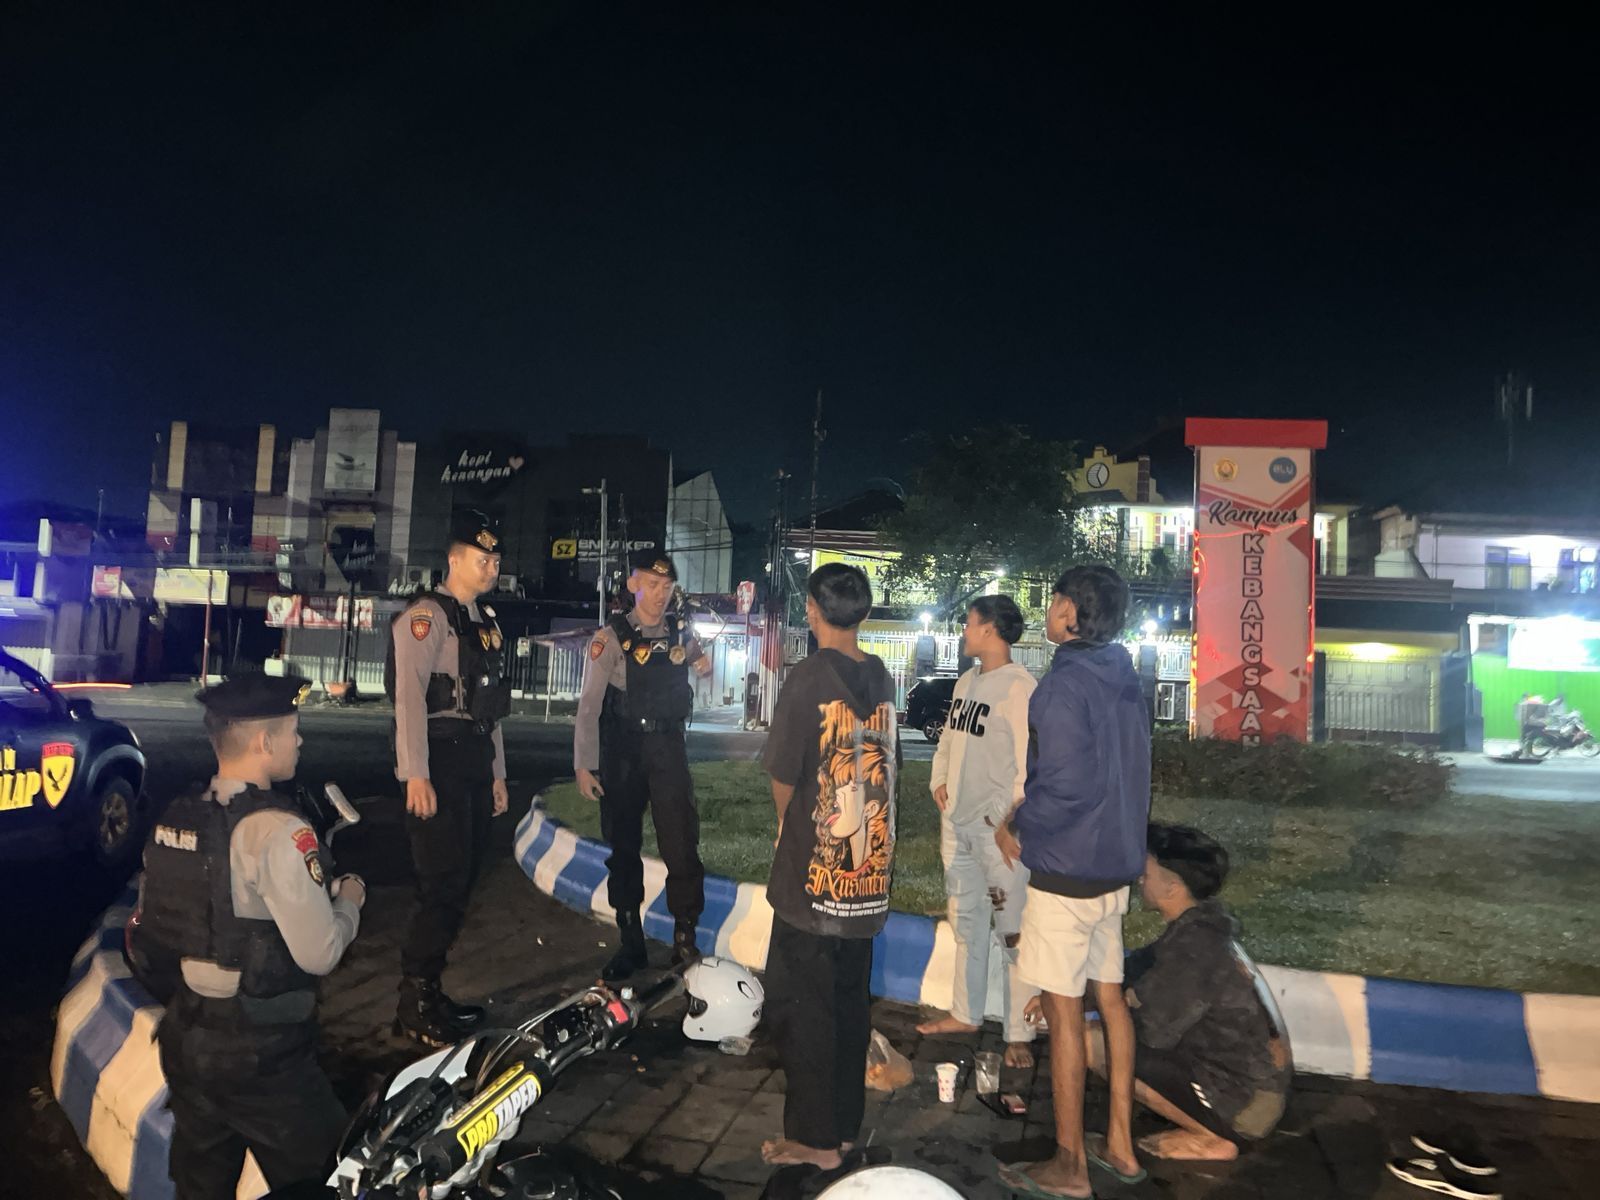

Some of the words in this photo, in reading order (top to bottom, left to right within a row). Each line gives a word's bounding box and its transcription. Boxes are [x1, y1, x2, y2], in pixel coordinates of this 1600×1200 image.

[458, 449, 492, 467] kopi
[440, 465, 511, 483] kenangan
[1208, 500, 1298, 530] Kampus
[950, 698, 991, 738] CHIC
[155, 824, 198, 851] POLISI
